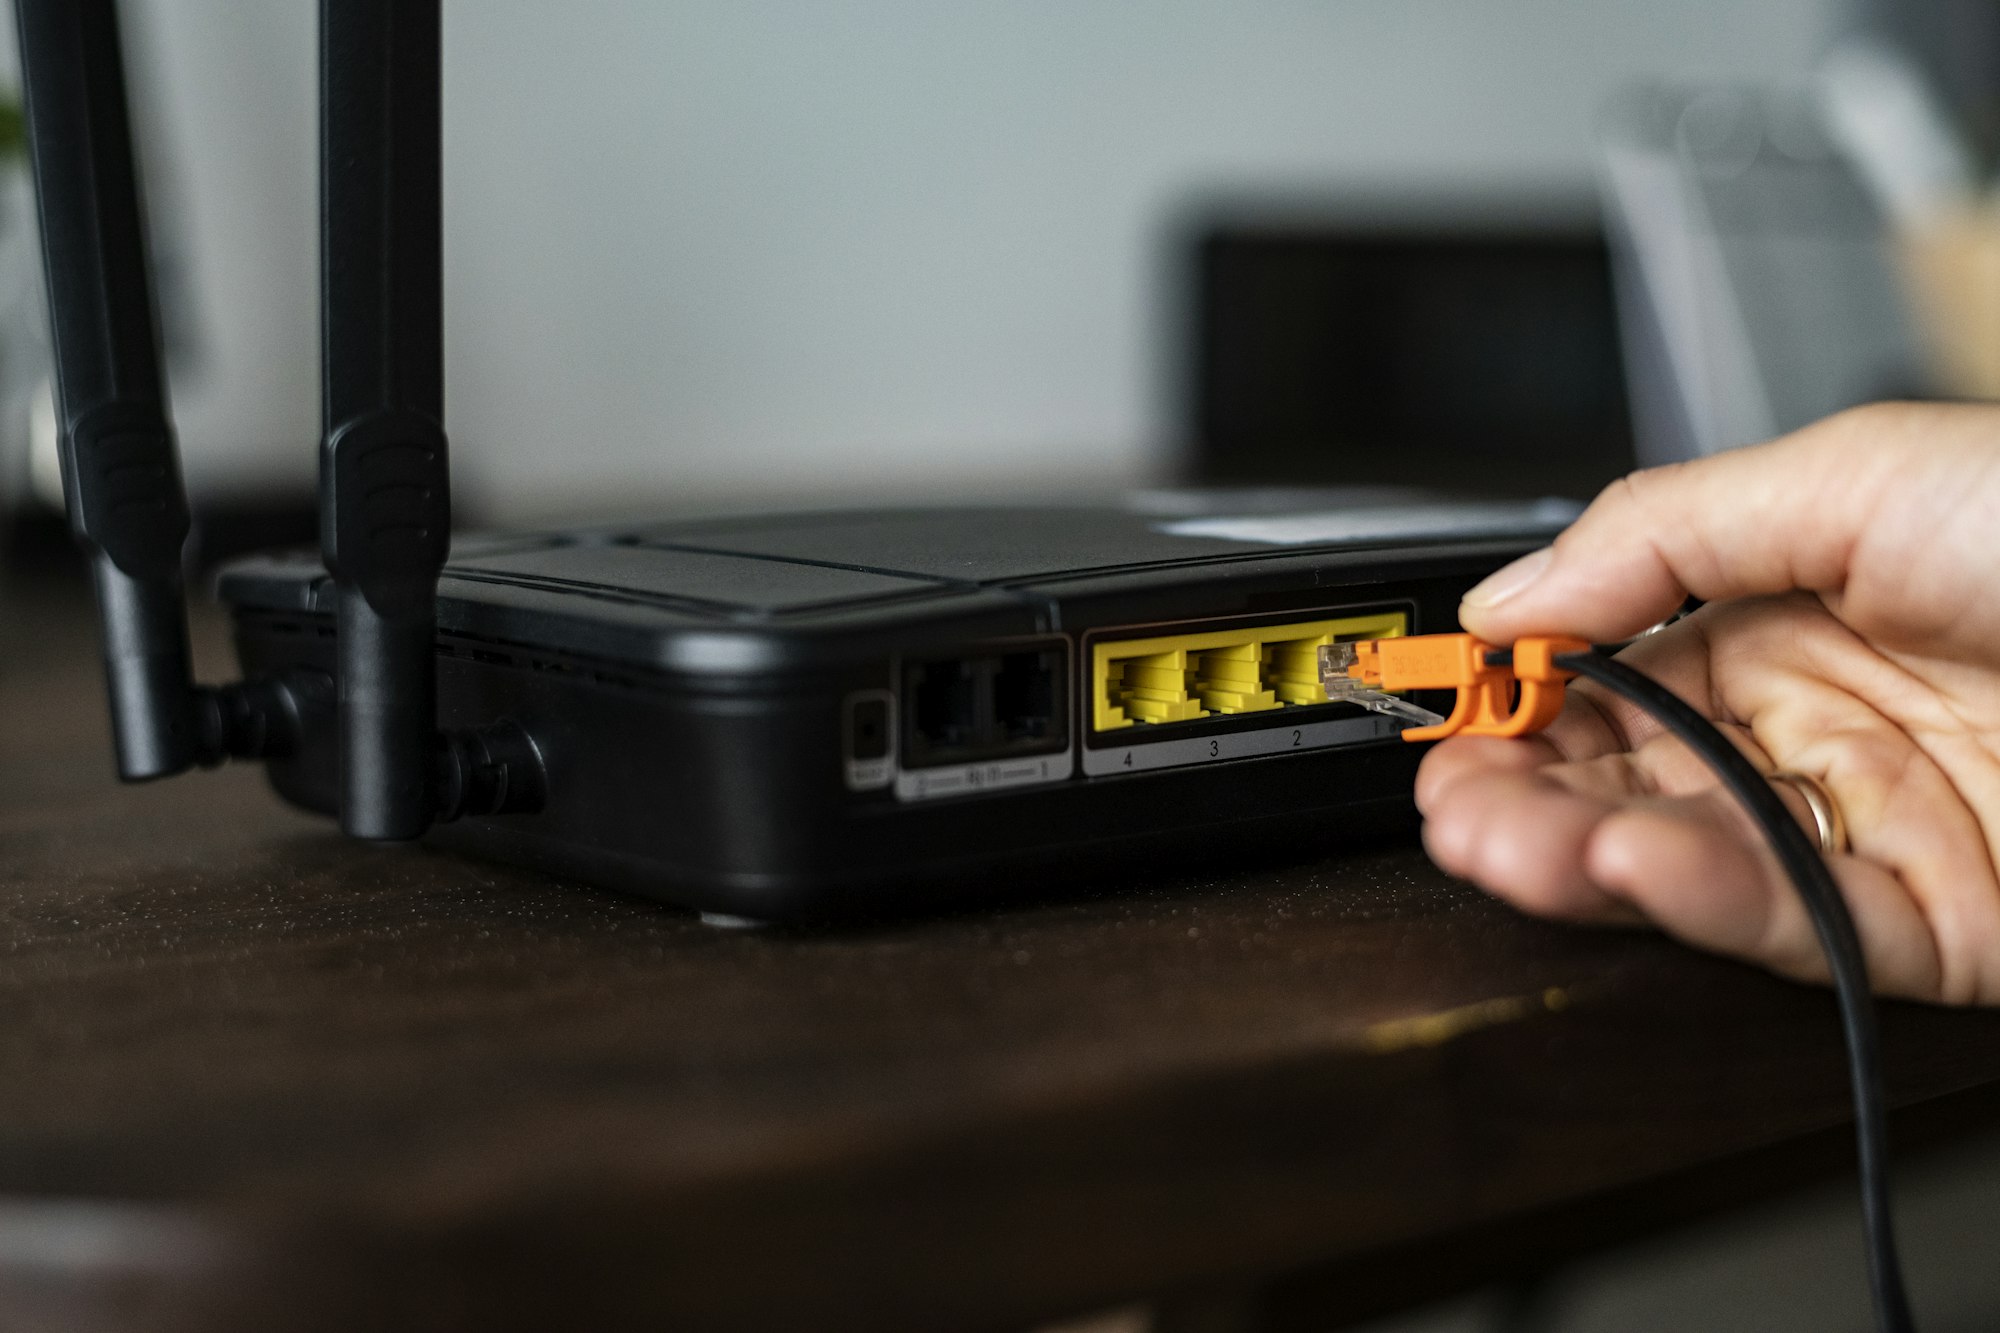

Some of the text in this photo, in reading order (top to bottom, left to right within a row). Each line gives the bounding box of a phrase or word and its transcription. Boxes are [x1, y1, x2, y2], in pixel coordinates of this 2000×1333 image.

[1123, 719, 1379, 767] 4 3 2 1
